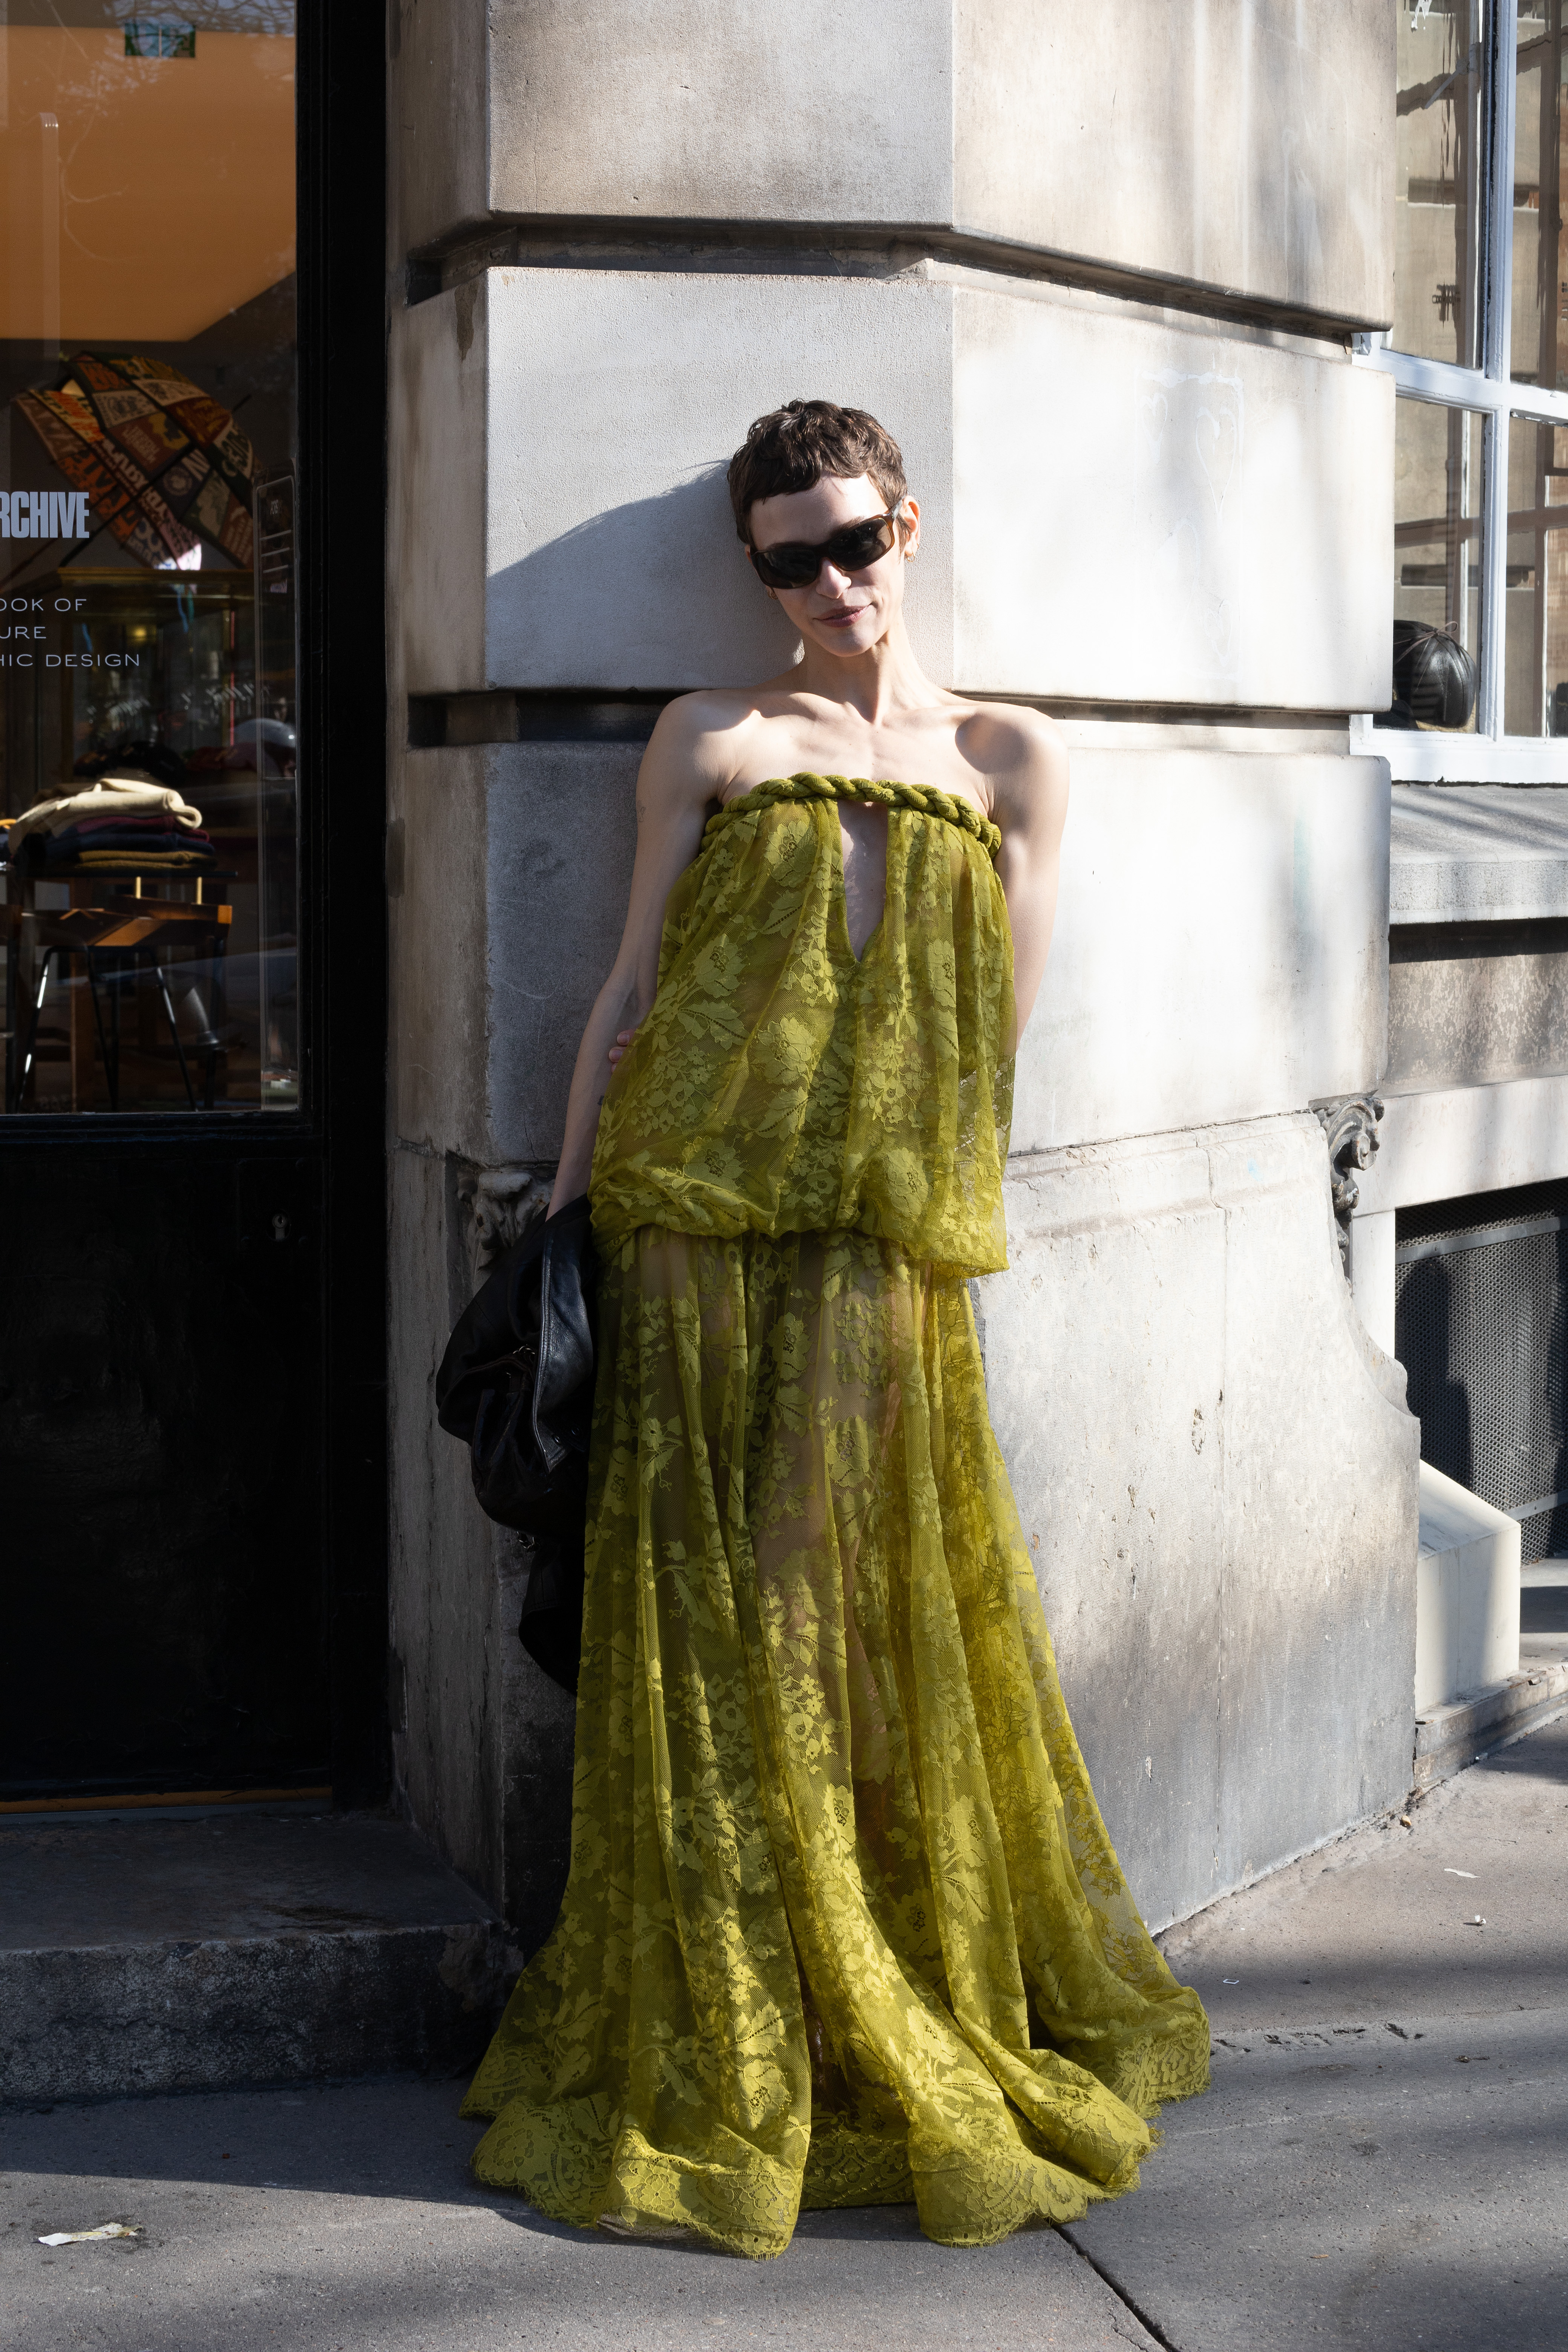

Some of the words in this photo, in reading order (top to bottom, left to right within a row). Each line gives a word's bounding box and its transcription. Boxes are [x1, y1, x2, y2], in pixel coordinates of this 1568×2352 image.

[0, 491, 89, 538] RCHIVE
[55, 599, 86, 611] OF
[46, 654, 139, 666] DESIGN
